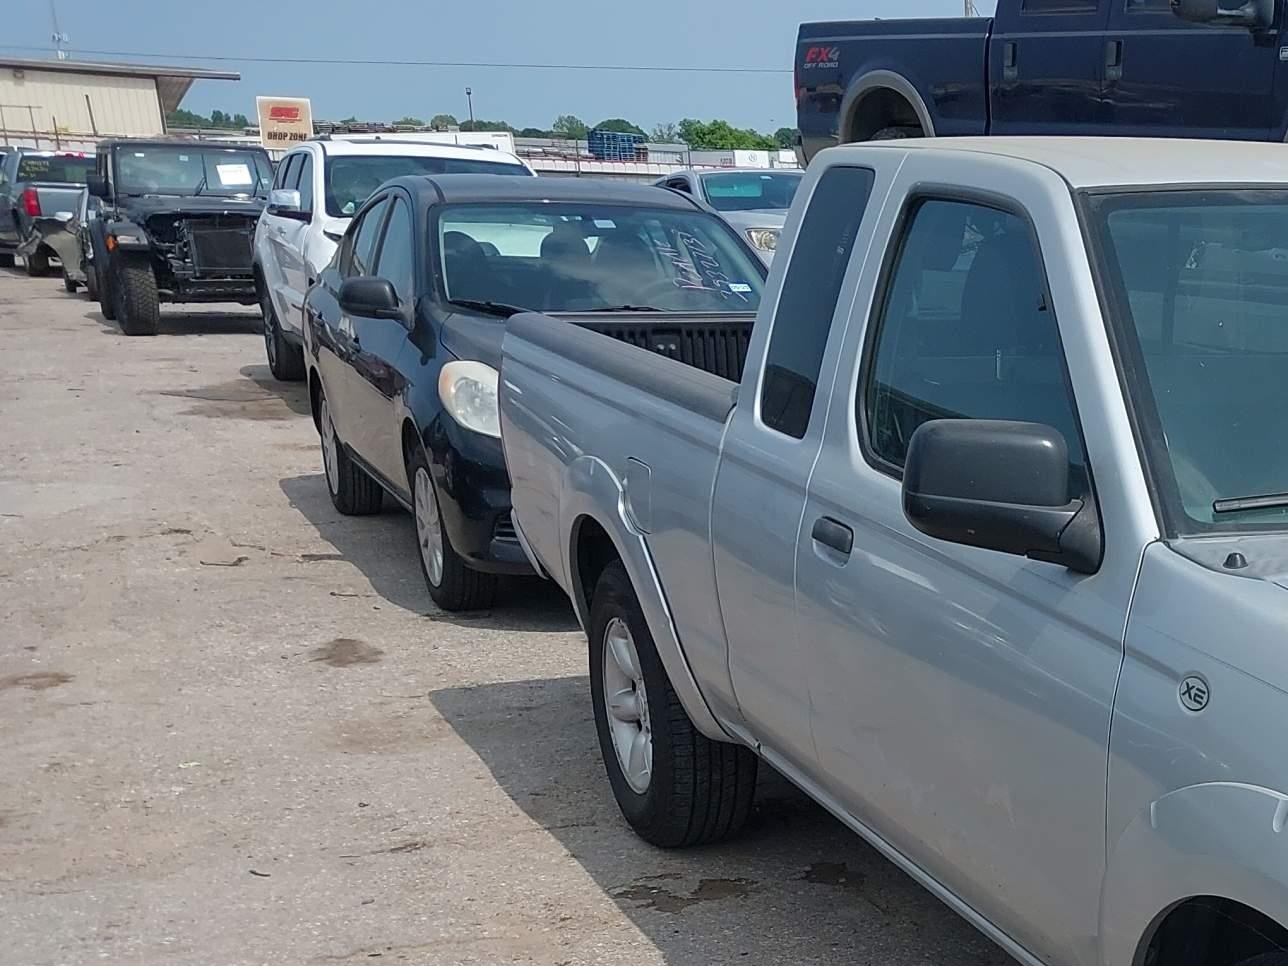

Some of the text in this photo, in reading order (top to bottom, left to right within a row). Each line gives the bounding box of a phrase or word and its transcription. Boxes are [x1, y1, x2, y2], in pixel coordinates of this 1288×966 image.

[806, 47, 840, 62] FX4
[818, 61, 839, 69] ROAD
[267, 131, 288, 141] DROP
[1181, 680, 1207, 706] XE
